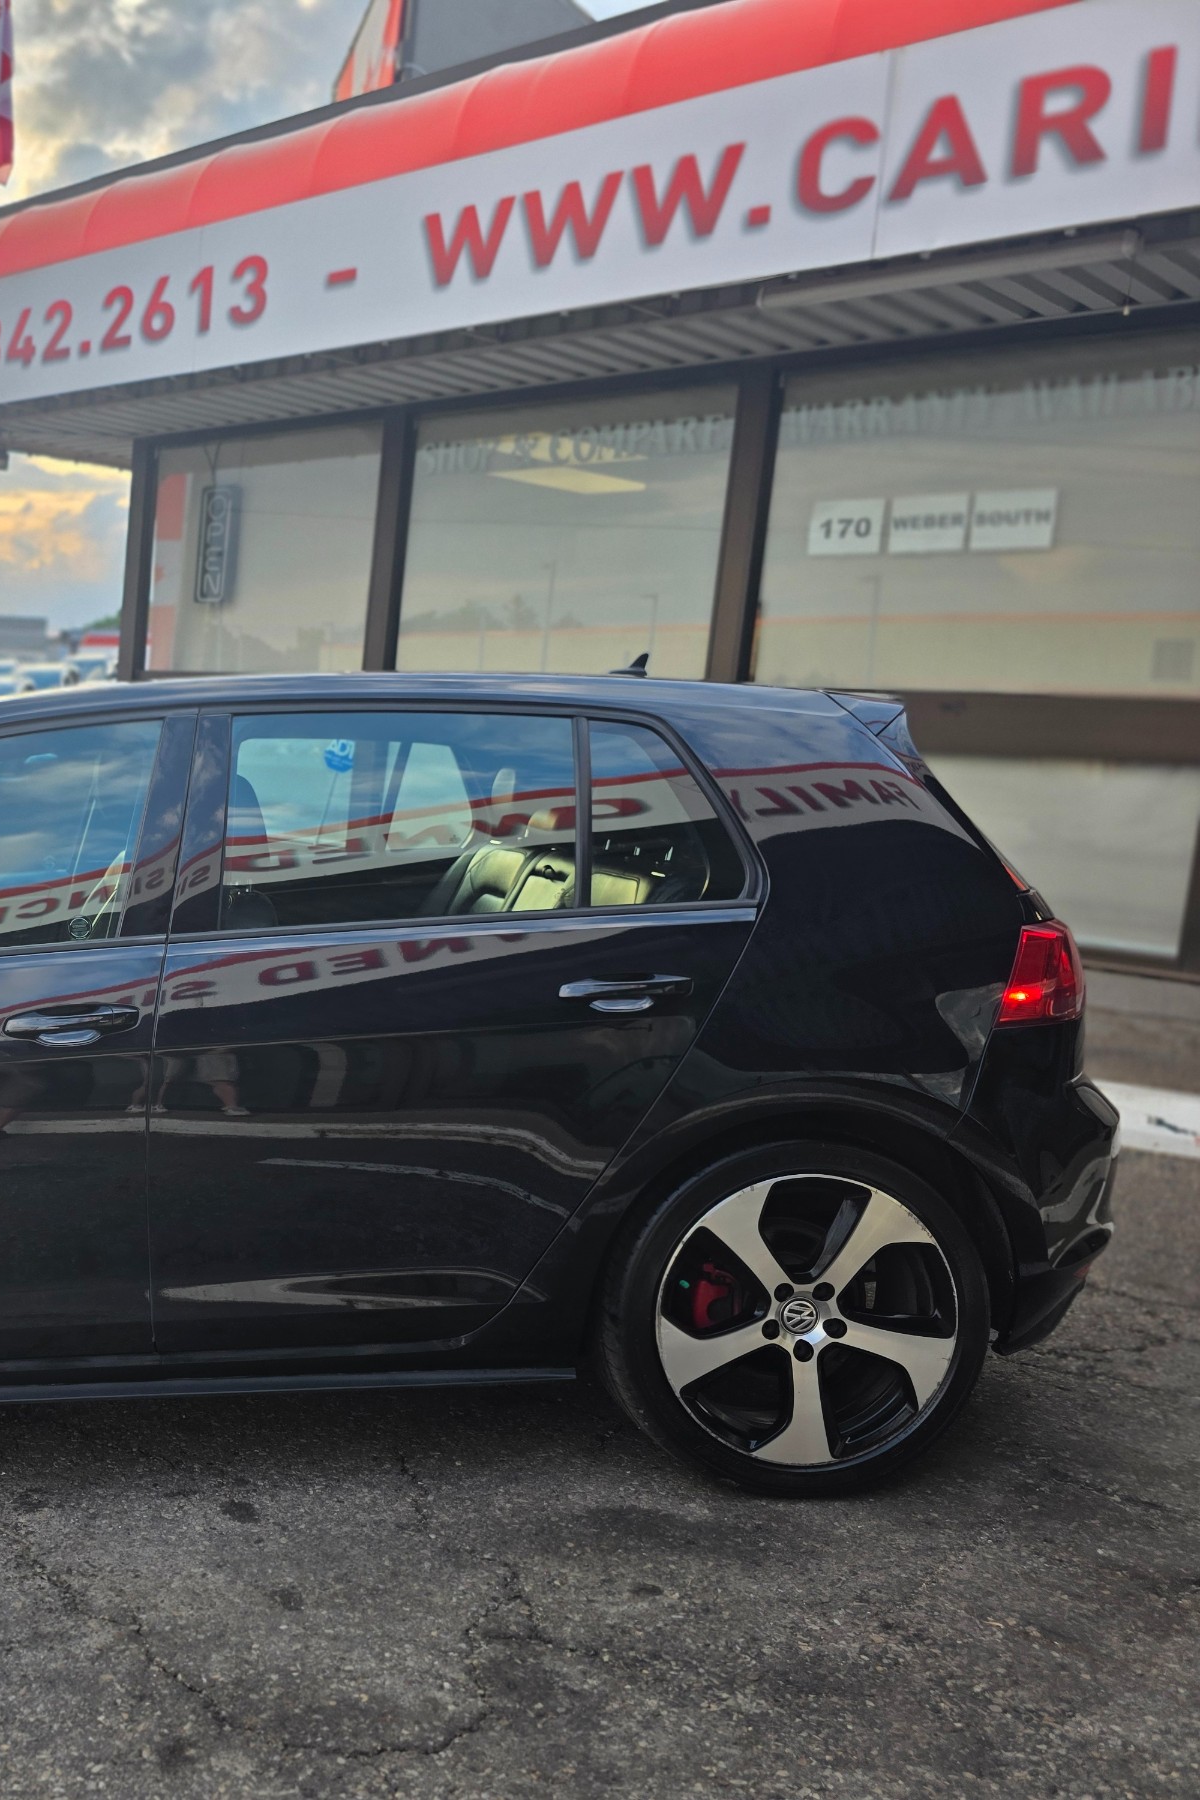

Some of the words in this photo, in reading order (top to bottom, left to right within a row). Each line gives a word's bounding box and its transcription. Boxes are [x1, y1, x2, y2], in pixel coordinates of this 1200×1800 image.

[424, 44, 1200, 286] WWW.CARI
[819, 517, 872, 540] 170
[892, 512, 965, 532] WEBER
[974, 508, 1051, 528] SOUTH
